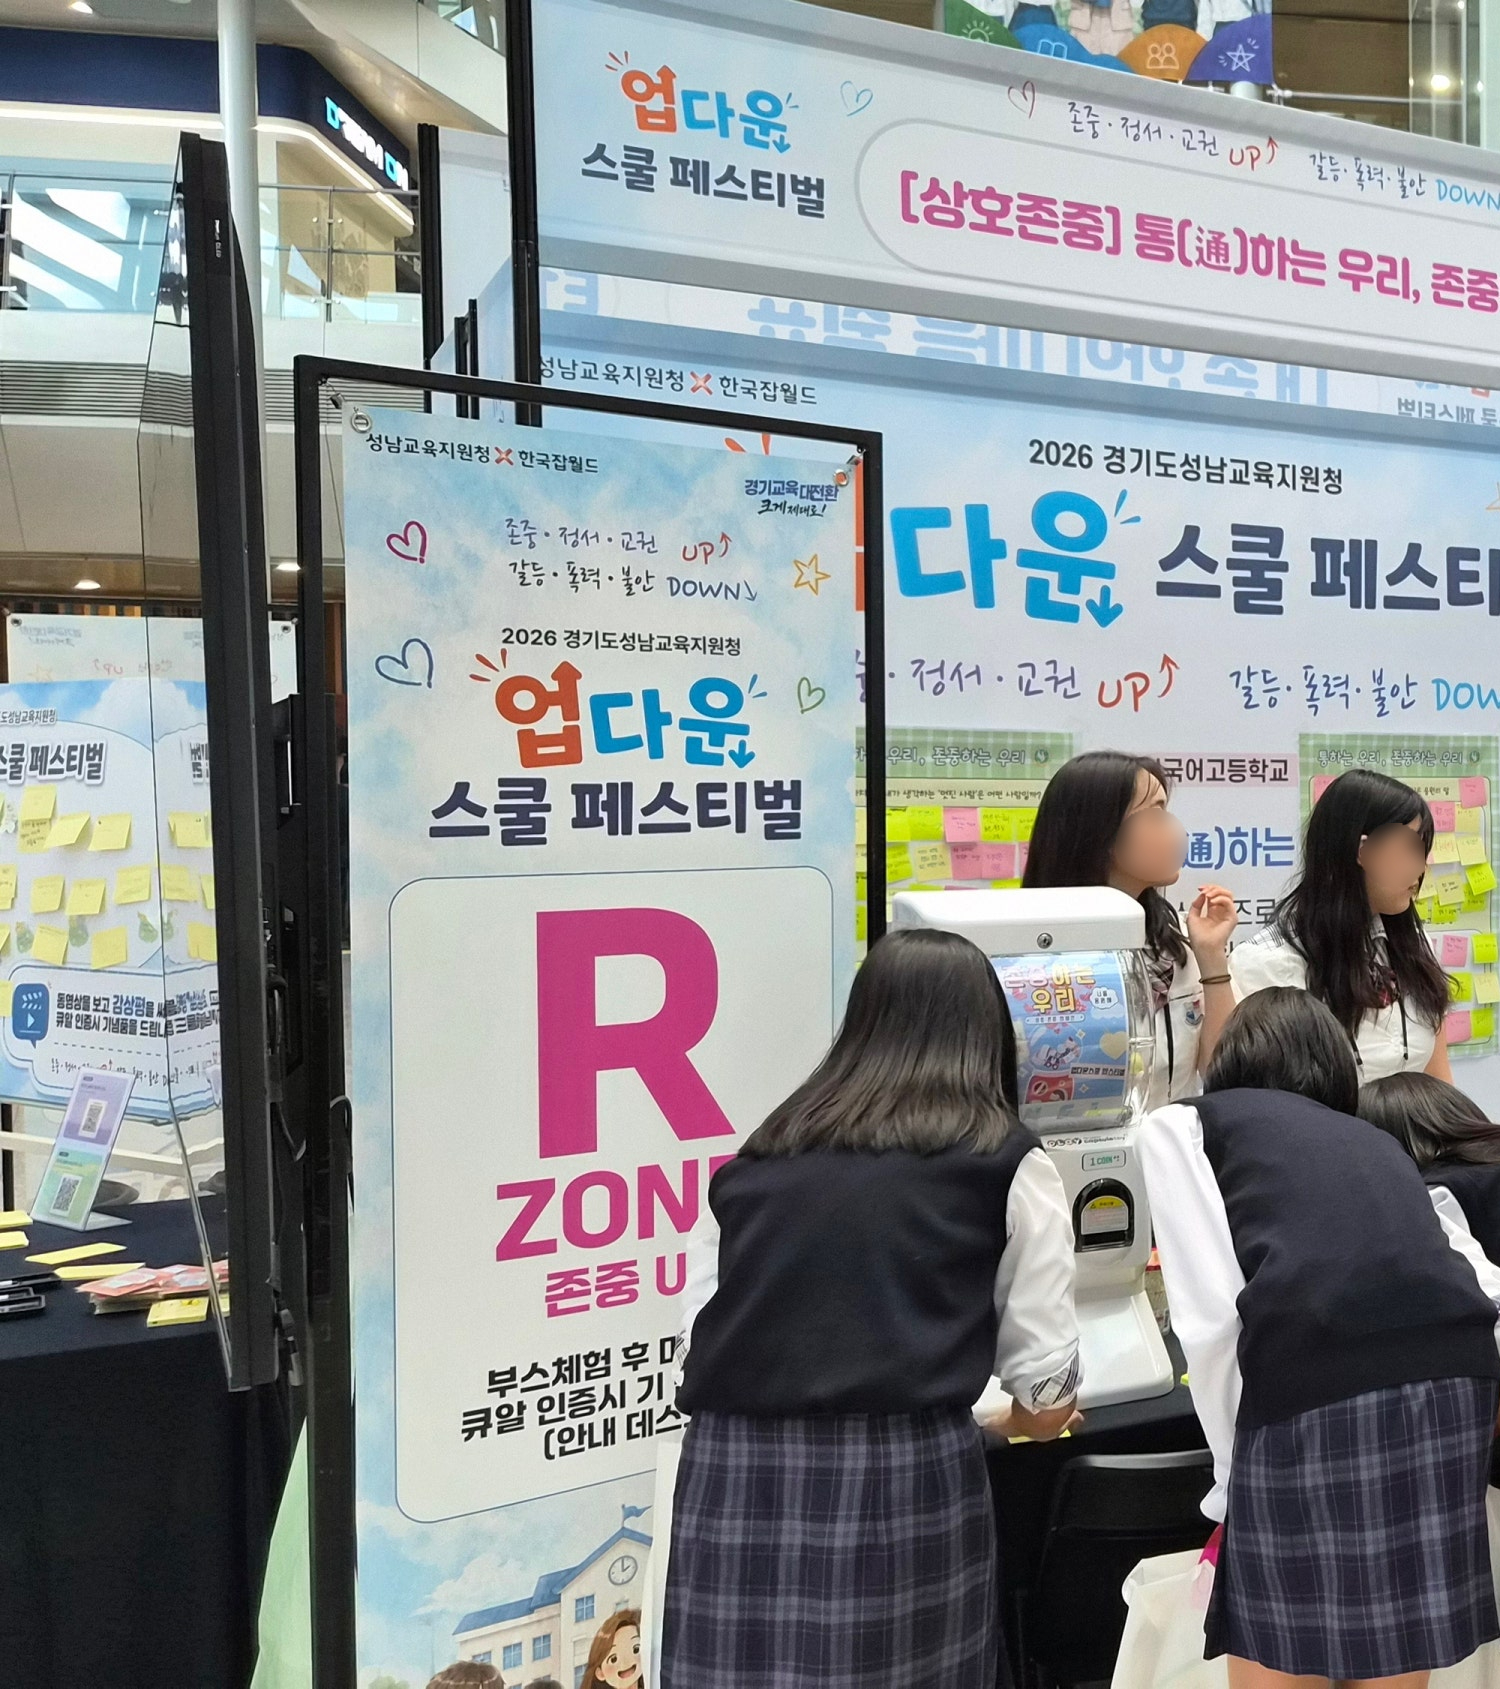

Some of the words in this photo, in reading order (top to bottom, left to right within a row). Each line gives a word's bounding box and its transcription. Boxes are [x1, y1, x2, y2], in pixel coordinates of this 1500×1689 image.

[620, 64, 791, 153] 업다운
[581, 143, 659, 193] 스쿨
[668, 155, 826, 219] 페스티벌
[1229, 144, 1262, 171] UP
[900, 170, 1121, 256] [상호존중]
[1134, 212, 1328, 288] 통(通)하는
[1338, 248, 1421, 305] 우리,
[719, 375, 817, 405] 한국잡월드
[366, 433, 490, 465] 성남교육지원청
[518, 449, 598, 475] 한국잡월드
[1028, 439, 1094, 471] 2026
[1103, 444, 1344, 496] 경기도성남교육지원청
[505, 517, 537, 549] 존중
[559, 524, 600, 548] 정서
[620, 529, 659, 554] 교권
[682, 542, 714, 565] UP
[889, 490, 1123, 629] 다운
[1155, 522, 1290, 617] 스쿨
[508, 560, 545, 587] 갈등
[566, 562, 602, 593] 폭력
[620, 565, 656, 596] 불안
[667, 575, 741, 601] DOWN
[501, 627, 558, 648] 2026
[563, 629, 742, 657] 경기도성남교육지원청
[911, 657, 983, 697] 정서
[1017, 661, 1079, 701] 교권
[1098, 671, 1150, 713] UP
[0, 709, 56, 724] 도성남교육지원청
[495, 660, 756, 769] 업다운
[29, 743, 104, 780] 페스티벌
[932, 746, 991, 767] 존중하는
[996, 749, 1026, 767] 우리
[1157, 758, 1289, 783] 국어고등학교
[1317, 750, 1353, 768] 통하는
[1391, 750, 1437, 767] 존중하는
[1440, 752, 1463, 768] 우리
[429, 777, 553, 846] 스쿨
[570, 779, 802, 842] 페스티벌
[56, 1012, 72, 1029] 큐알
[75, 1013, 100, 1031] 인증시
[102, 1016, 138, 1036] 기념품을
[57, 992, 91, 1011] 동영상을
[93, 994, 110, 1013] 보고
[112, 994, 155, 1018] 감상평을
[537, 907, 736, 1159] R
[496, 1153, 738, 1262] ZON
[545, 1259, 640, 1319] 존중
[487, 1347, 611, 1399] 부스체험
[621, 1341, 649, 1372] 후
[461, 1400, 527, 1442] 큐알
[537, 1379, 626, 1426] 인증시
[544, 1416, 616, 1461] (안내
[626, 1405, 691, 1441] 데스
